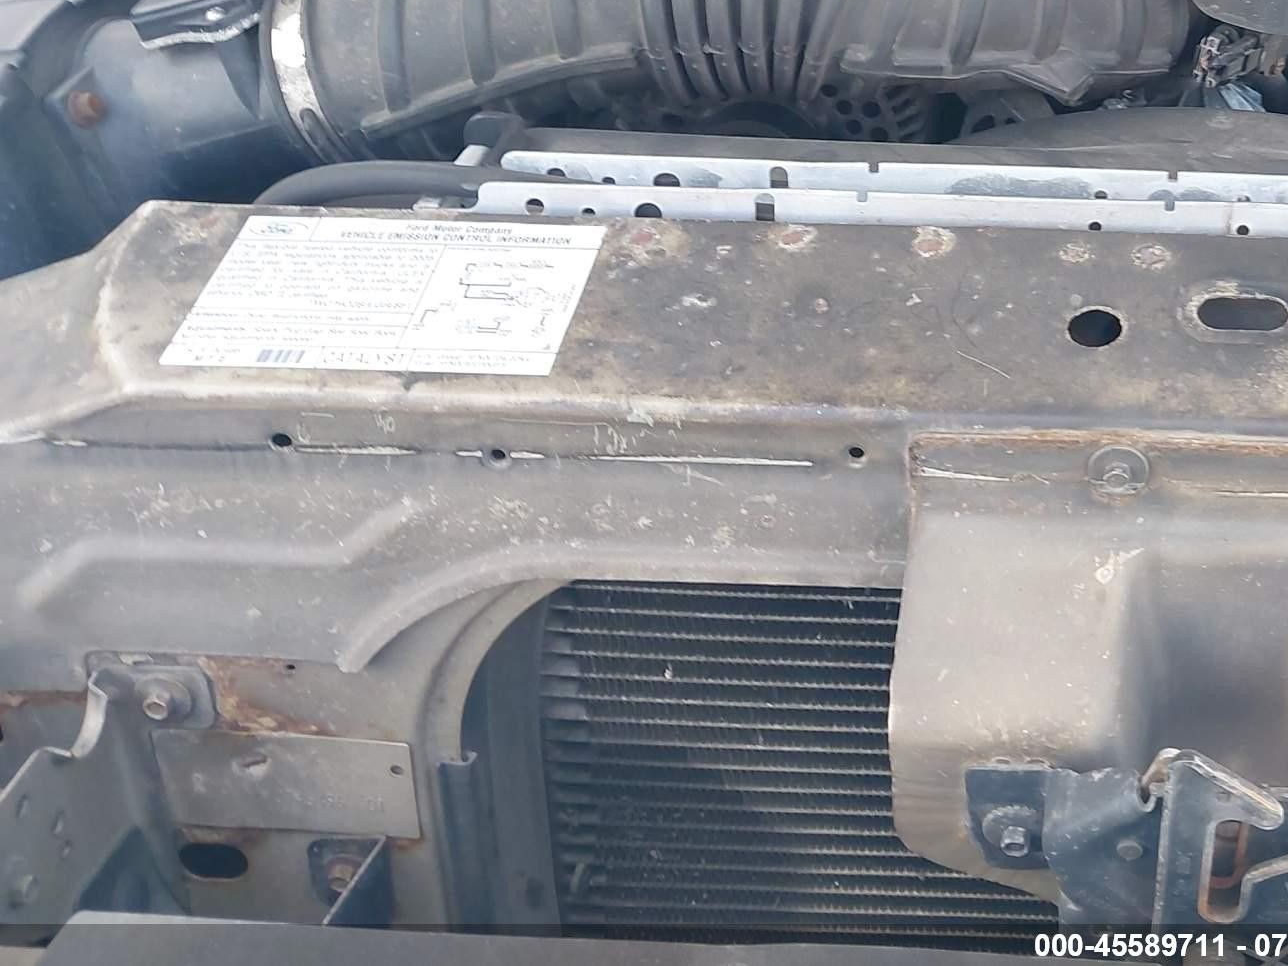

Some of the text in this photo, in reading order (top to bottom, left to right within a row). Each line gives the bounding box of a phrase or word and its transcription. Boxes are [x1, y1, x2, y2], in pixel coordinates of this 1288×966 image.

[433, 224, 463, 233] Motor
[466, 225, 513, 235] Company
[340, 230, 572, 245] VEHICLE EMISSION CONTROL INFORMATION
